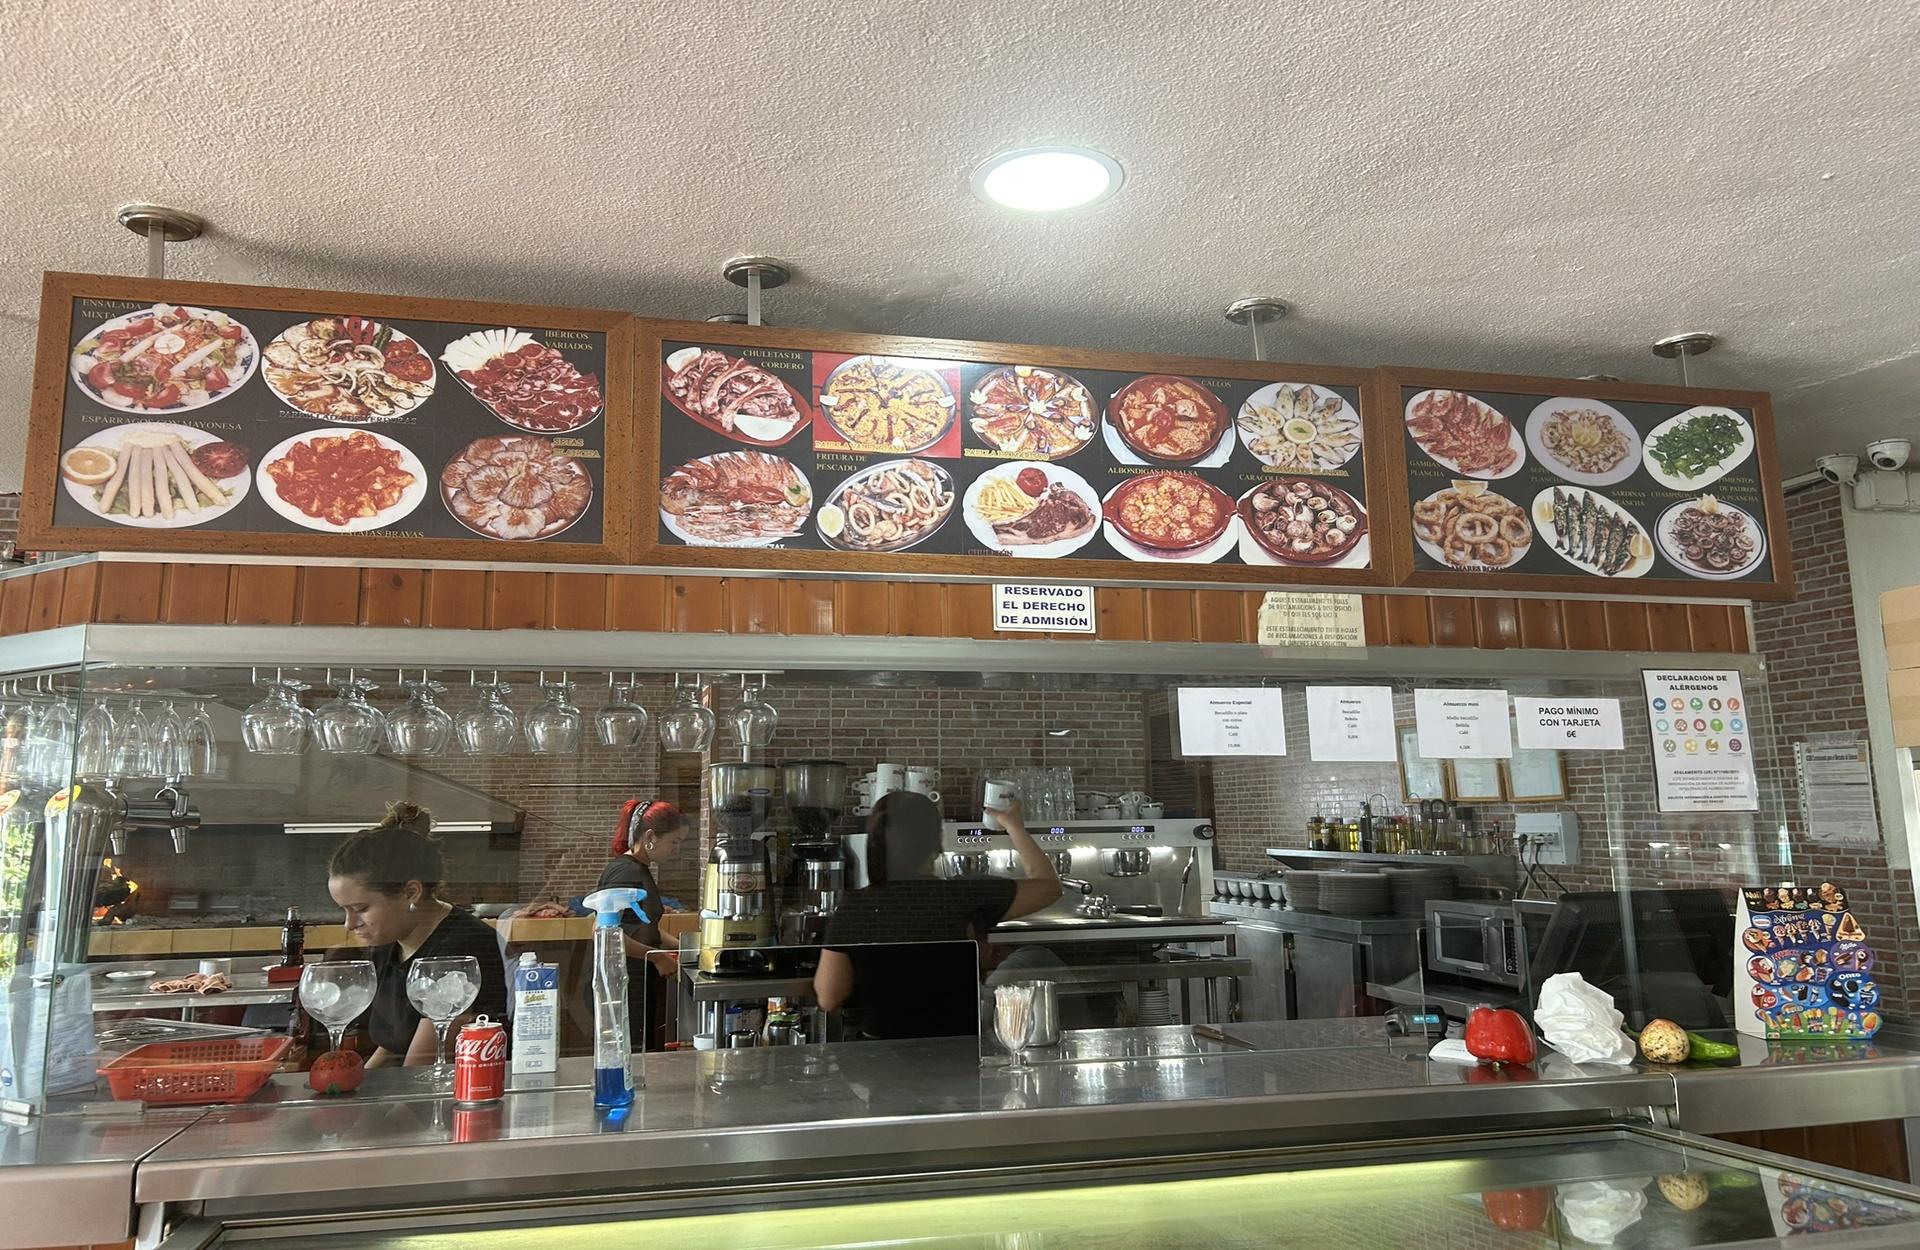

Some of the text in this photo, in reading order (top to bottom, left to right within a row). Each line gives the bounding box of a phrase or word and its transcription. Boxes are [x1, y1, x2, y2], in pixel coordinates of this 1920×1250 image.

[82, 299, 142, 310] ENSALADA
[81, 310, 117, 319] MIXTA
[545, 341, 593, 350] VARIADOS
[743, 349, 790, 358] CHULETAS
[761, 361, 805, 370] CORDERO
[1201, 380, 1231, 388] CALLOS
[180, 420, 242, 431] MAYONESA
[816, 452, 867, 462] FRITURA DE
[816, 463, 857, 472] PESCADO
[1173, 469, 1199, 477] SALSA
[385, 530, 424, 538] BRAVAS
[1004, 586, 1083, 597] RESERVADO
[1002, 600, 1085, 612] EL DERECHO
[1001, 615, 1088, 626] DE ADMISIÓN
[1656, 674, 1714, 682] DECLARACIÓN
[1669, 682, 1718, 691] ALÉRGENOS
[1538, 705, 1599, 715] PAGO MÍNIMO
[1539, 719, 1601, 727] CON TARJETA
[1566, 730, 1577, 738] 6€
